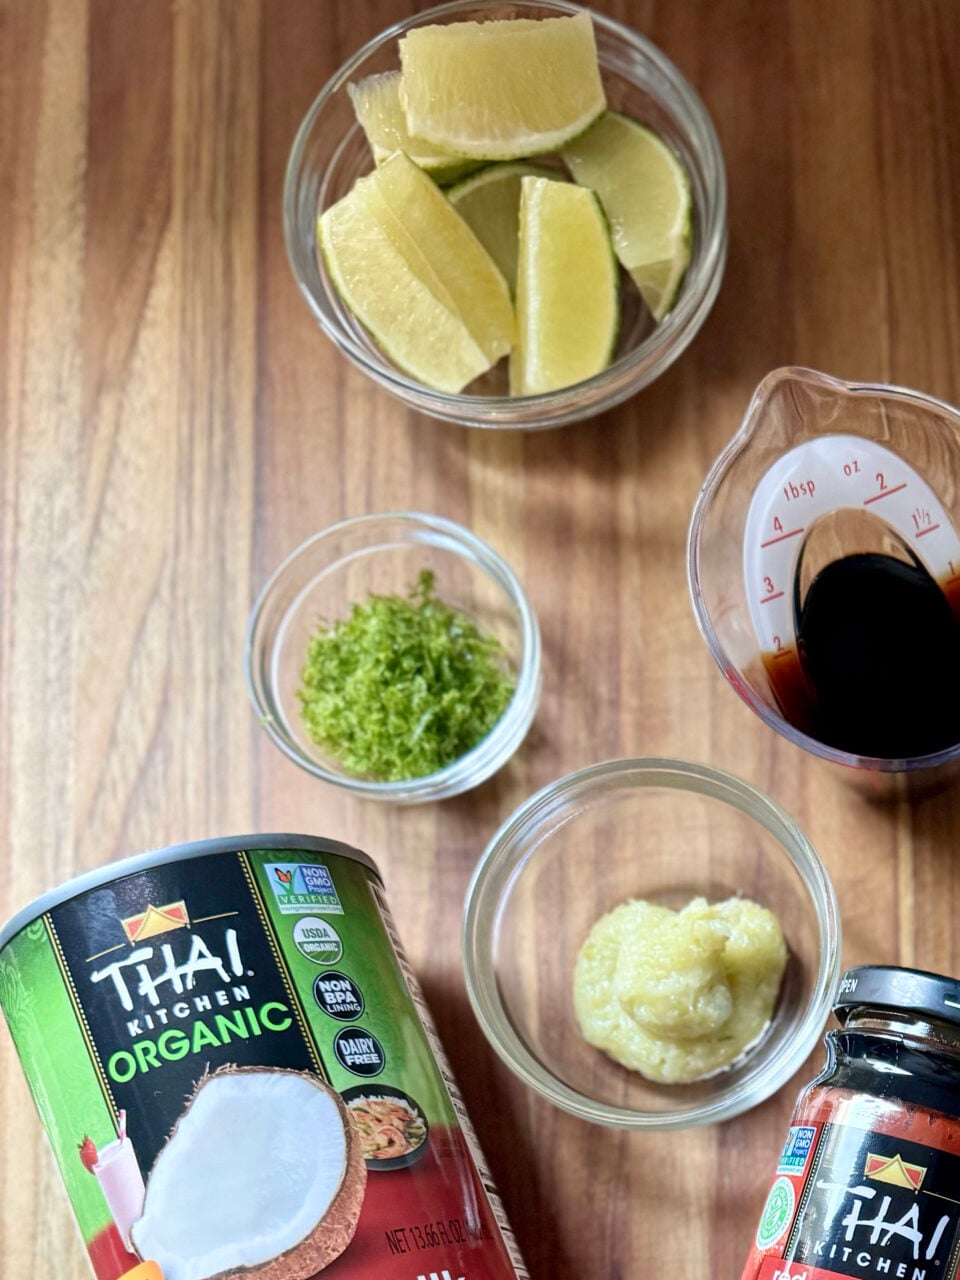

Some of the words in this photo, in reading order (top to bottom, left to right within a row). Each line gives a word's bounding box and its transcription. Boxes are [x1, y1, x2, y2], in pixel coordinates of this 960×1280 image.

[843, 461, 861, 476] oz
[876, 472, 888, 491] 2
[783, 479, 816, 501] tbsp
[773, 516, 784, 533] 4
[763, 576, 775, 593] 3
[773, 636, 784, 651] 2
[302, 867, 327, 878] NON
[305, 876, 331, 888] GMO
[308, 885, 334, 895] Project
[280, 895, 337, 904] VERIFIED
[301, 928, 331, 939] USDA
[303, 941, 339, 953] ORGANIC
[90, 928, 243, 1011] THAI
[318, 980, 352, 993] NON
[322, 991, 357, 1005] BPA
[126, 985, 250, 1037] KITCHEN
[326, 1002, 361, 1013] LINING
[108, 1001, 292, 1083] ORGANIC
[339, 1038, 375, 1055] DAIRY
[343, 1053, 381, 1066] FREE
[816, 1178, 950, 1260] THAI
[385, 1228, 410, 1255] NET
[409, 1222, 440, 1250] 13.66
